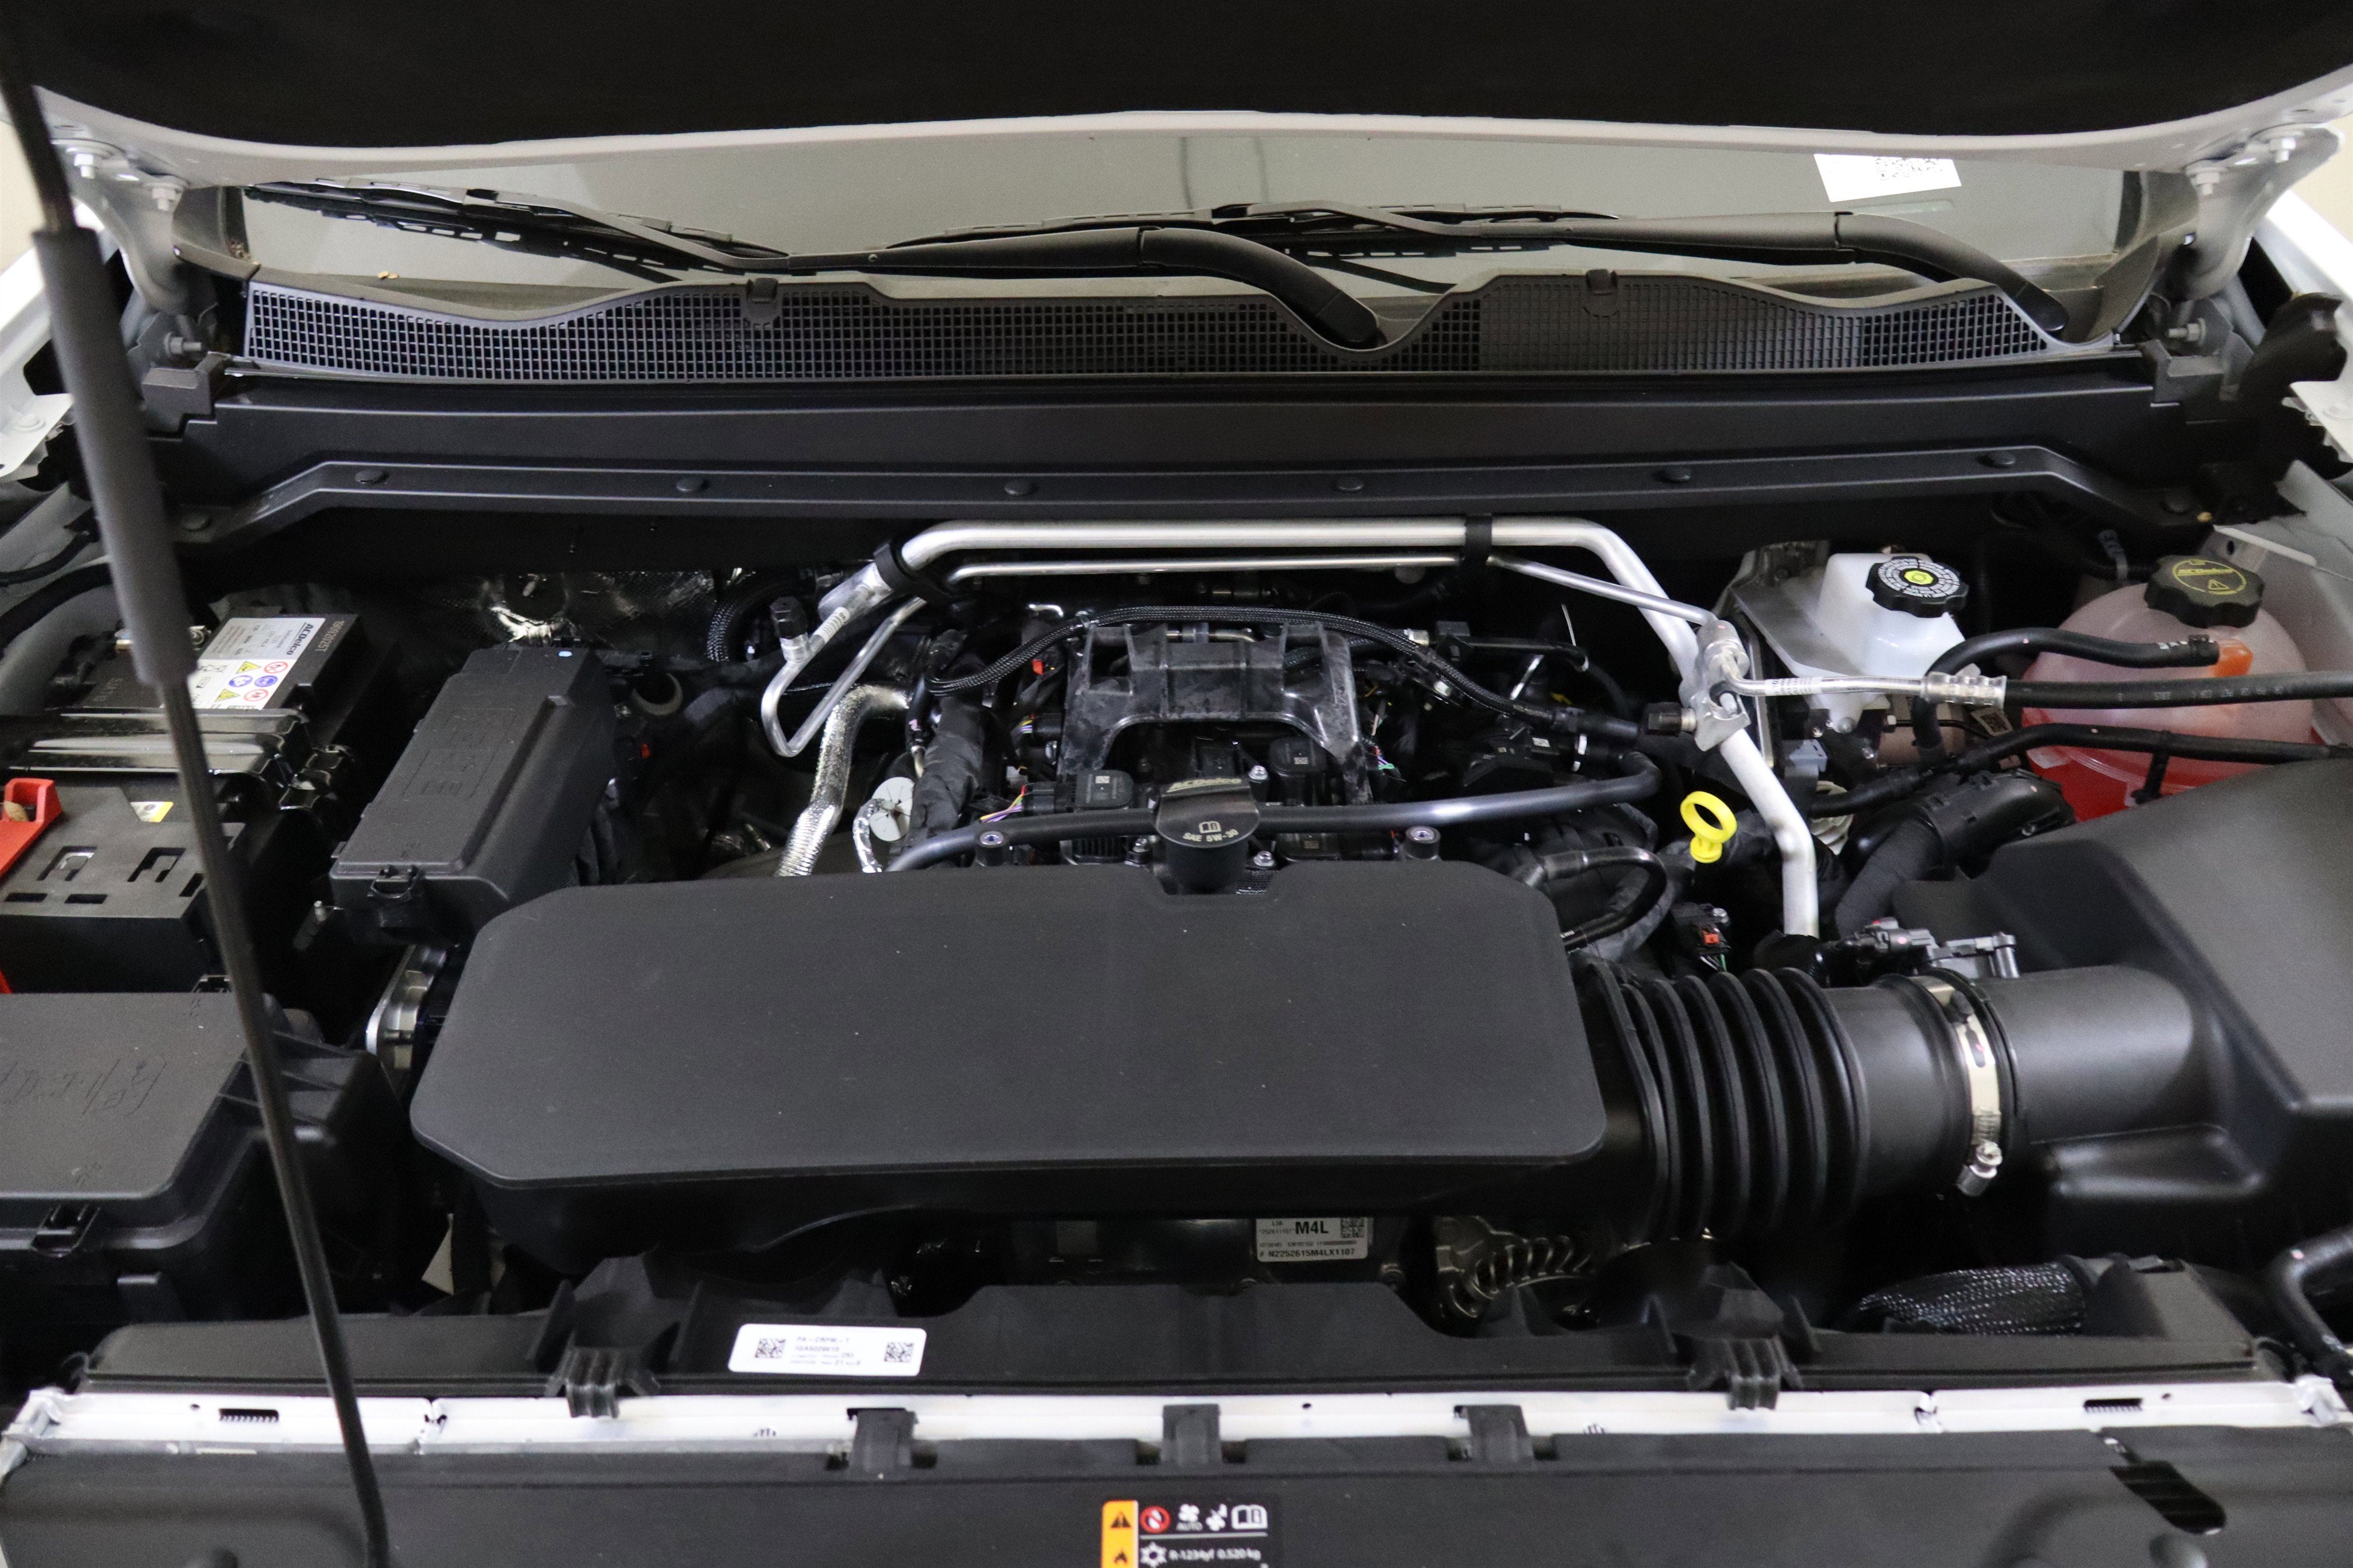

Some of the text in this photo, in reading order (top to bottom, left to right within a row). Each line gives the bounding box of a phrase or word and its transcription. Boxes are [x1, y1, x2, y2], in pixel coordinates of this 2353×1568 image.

[286, 623, 314, 655] ACDelco
[1167, 778, 1242, 792] ACDelco
[1182, 832, 1202, 842] SAE
[1295, 1220, 1329, 1234] M4L
